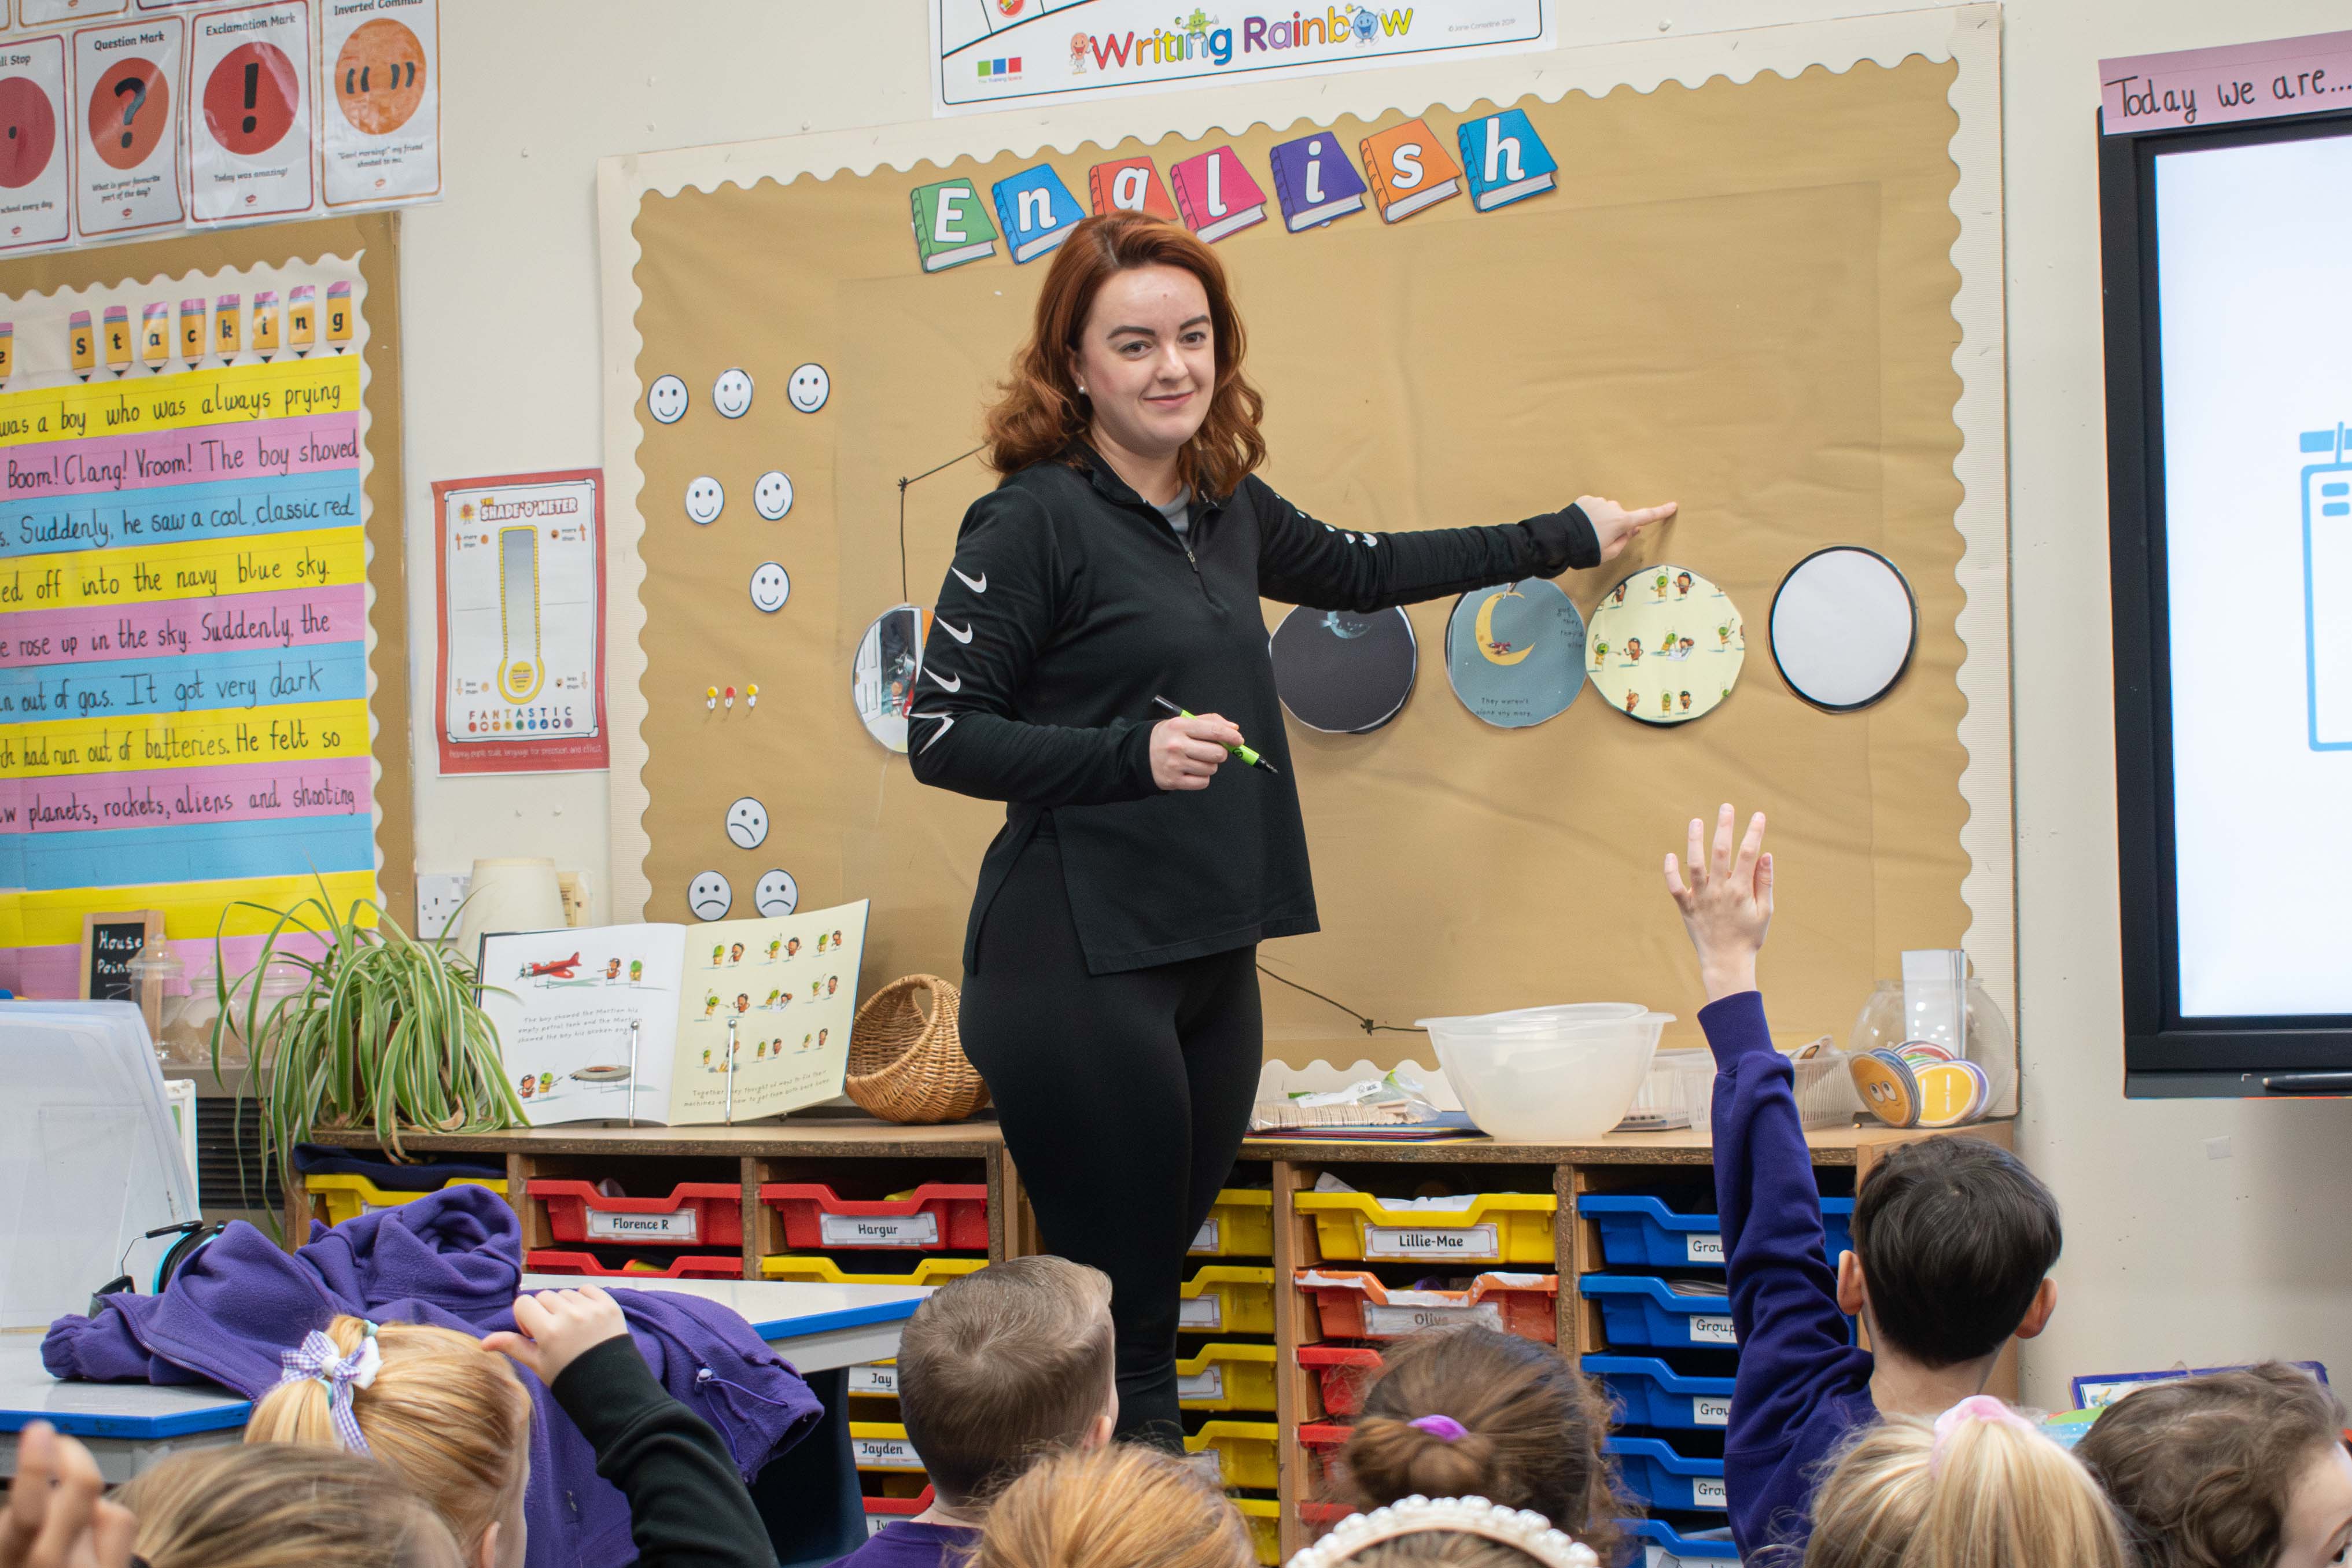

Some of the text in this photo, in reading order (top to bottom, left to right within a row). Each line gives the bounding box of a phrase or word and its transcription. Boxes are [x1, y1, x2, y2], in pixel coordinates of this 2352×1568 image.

[334, 1, 374, 16] Inverted
[206, 13, 296, 36] Exclamation Mark
[94, 31, 164, 51] Question Mark
[1089, 6, 1413, 70] Writing Rainbow
[10, 55, 31, 66] Stop
[2104, 69, 2352, 123] Today we are...
[213, 174, 235, 183] Today
[254, 167, 288, 178] amazing!
[93, 183, 109, 191] What
[101, 194, 115, 203] part
[0, 382, 341, 437] was a boy who was always prying
[8, 456, 58, 489] Boom!
[64, 450, 128, 490] Clang!
[134, 444, 193, 478] Vroom!
[200, 441, 244, 473] The
[258, 436, 290, 476] boy
[20, 508, 114, 548] Suddenly,
[123, 510, 143, 535] he
[152, 512, 185, 532] saw
[192, 513, 204, 527] a
[210, 497, 248, 526] cool
[256, 494, 320, 525] classic
[324, 493, 355, 516] red
[36, 569, 62, 599] off
[83, 569, 120, 595] into
[134, 562, 162, 592] the
[176, 567, 217, 596] navy
[238, 552, 282, 584] blue
[296, 547, 331, 584] sky.
[19, 637, 51, 656] rose
[61, 636, 78, 656] up
[91, 628, 110, 651] in
[119, 619, 148, 649] the
[157, 617, 192, 654] sky.
[201, 606, 294, 648] Suddenly,
[300, 603, 330, 634] the
[21, 681, 47, 712] out
[54, 678, 71, 710] of
[79, 695, 114, 717] gas.
[120, 673, 158, 706] It
[175, 669, 205, 712] got
[216, 682, 257, 710] very
[270, 660, 324, 695] dark
[1481, 697, 1498, 706] They
[24, 736, 50, 767] had
[53, 748, 79, 766] run
[88, 729, 112, 763] out
[119, 730, 132, 762] of
[145, 728, 230, 760] batteries.
[237, 723, 260, 753] He
[270, 719, 309, 750] felt
[322, 732, 341, 748] so
[29, 792, 98, 829] planets,
[104, 786, 172, 819] rockets,
[176, 785, 234, 814] aliens
[249, 780, 281, 809] and
[293, 777, 355, 816] shooting
[99, 930, 143, 950] House
[692, 1089, 724, 1099] Together
[745, 1083, 769, 1094] thought
[756, 1094, 768, 1104] get
[613, 1217, 669, 1231] Florence R
[858, 1222, 899, 1238] Hargur
[1398, 1233, 1464, 1249] Lillie-Mae
[1693, 1240, 1723, 1252] Grou
[1696, 1319, 1735, 1337] Group
[871, 1373, 892, 1387] Jay
[1701, 1403, 1730, 1416] Grou
[862, 1442, 904, 1457] Jayden
[1698, 1483, 1726, 1496] Grou
[876, 1520, 887, 1530] Iv
